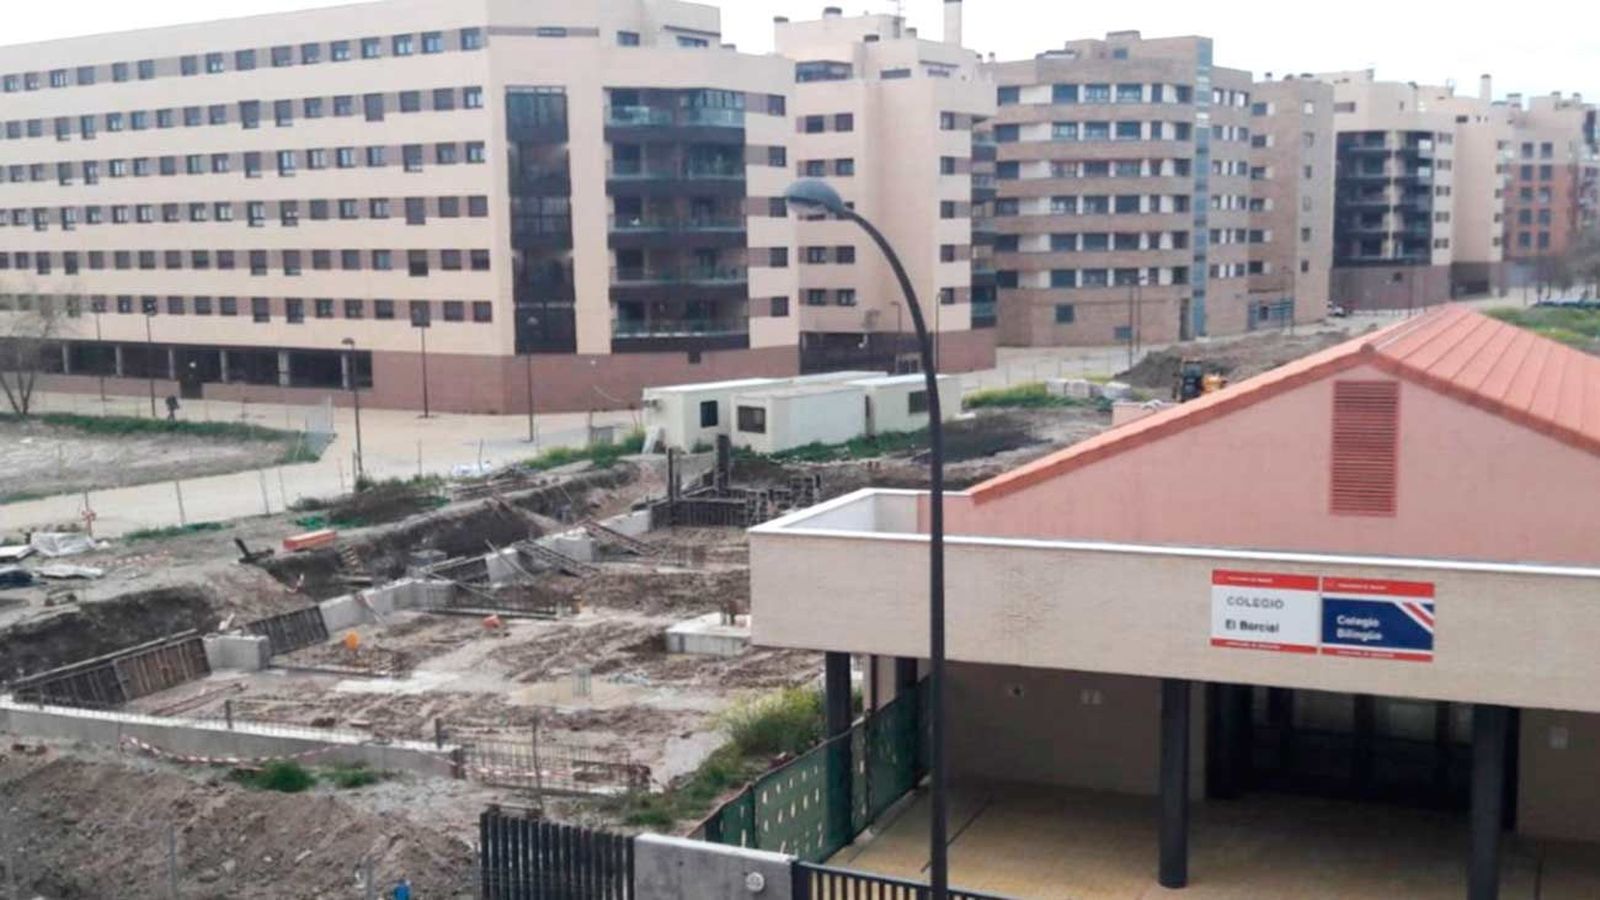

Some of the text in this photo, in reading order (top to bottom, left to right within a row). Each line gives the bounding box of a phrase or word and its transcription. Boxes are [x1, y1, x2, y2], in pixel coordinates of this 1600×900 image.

[1226, 596, 1285, 610] COLEGIO
[1225, 619, 1236, 630] El
[1336, 614, 1380, 628] Colegio
